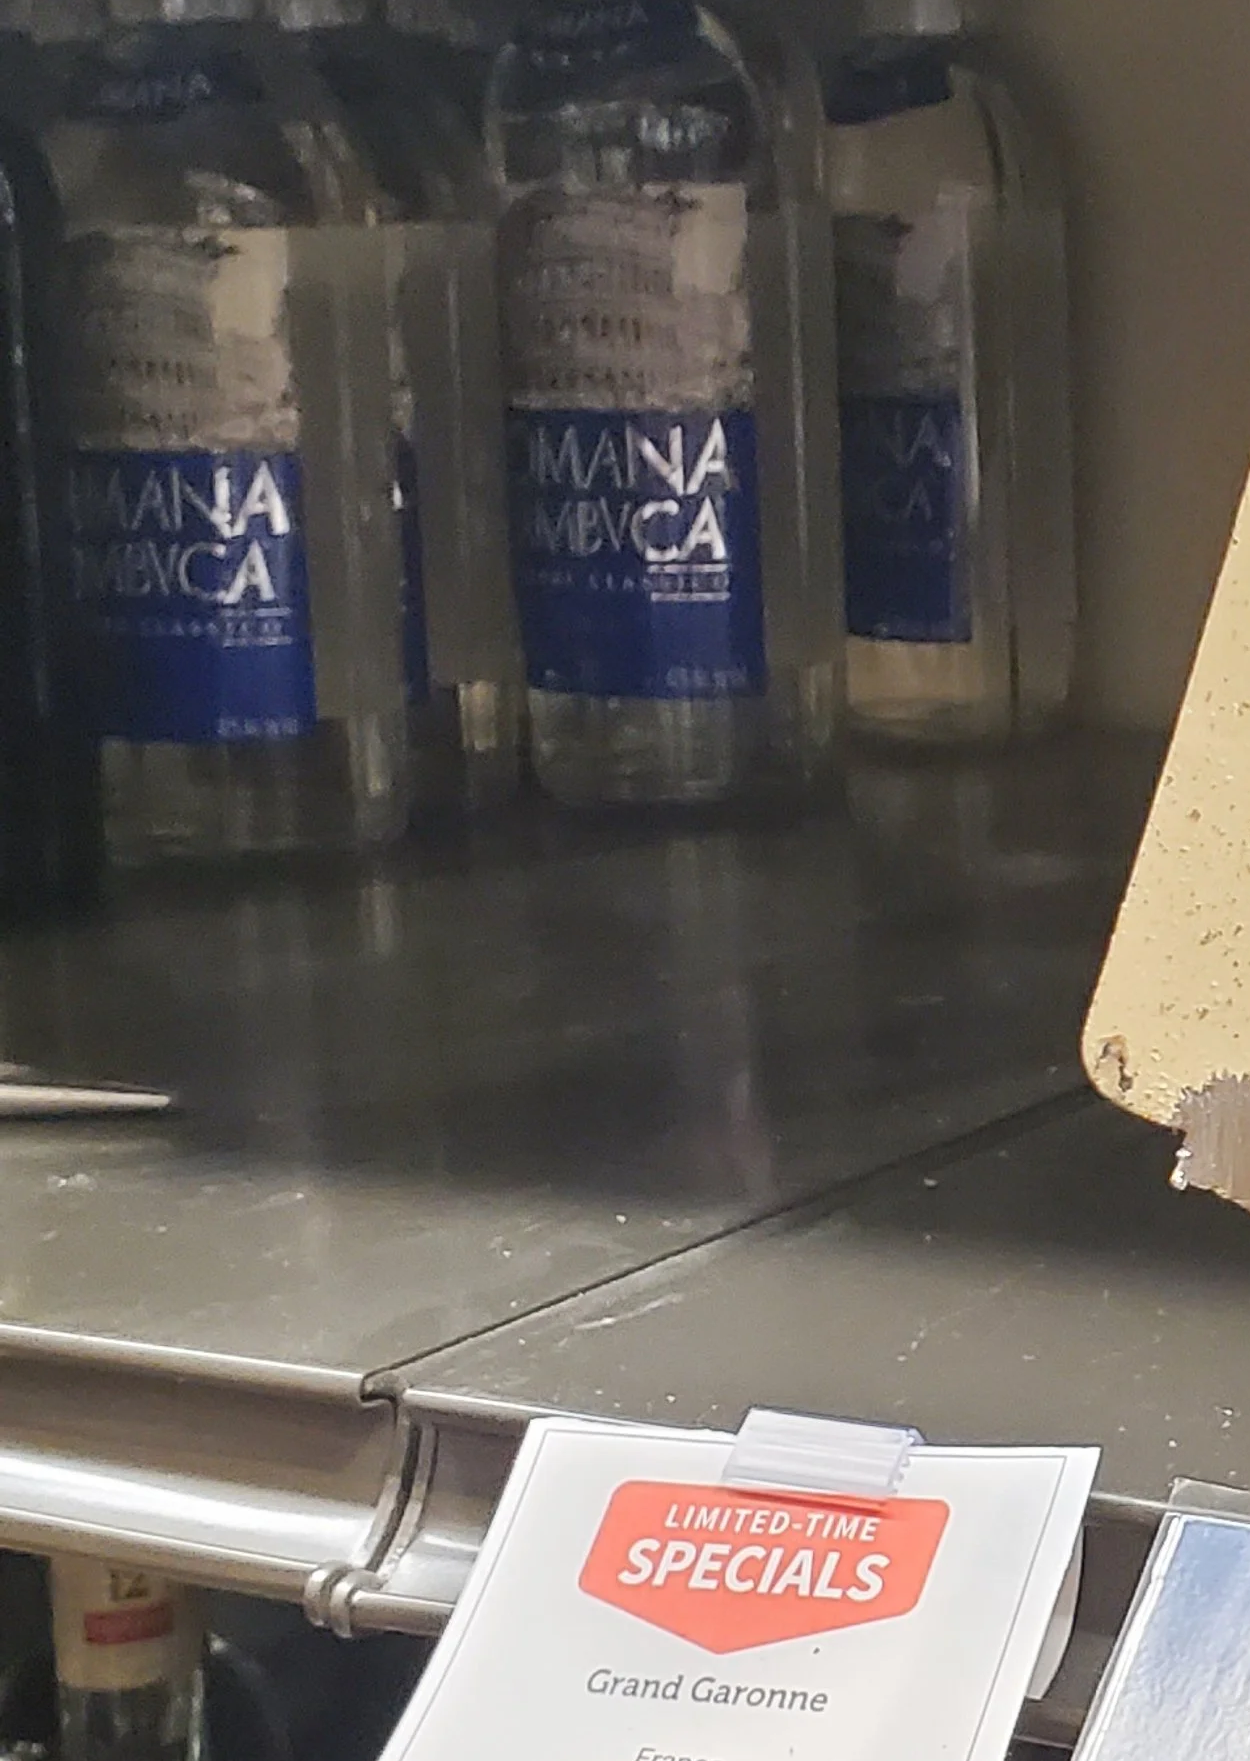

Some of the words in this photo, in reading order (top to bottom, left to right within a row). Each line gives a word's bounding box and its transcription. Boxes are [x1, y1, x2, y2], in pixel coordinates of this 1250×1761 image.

[665, 1503, 881, 1542] LIMITED-TIME
[618, 1539, 891, 1602] SPECIALS
[586, 1668, 682, 1702] Grand
[691, 1676, 829, 1712] Garonne
